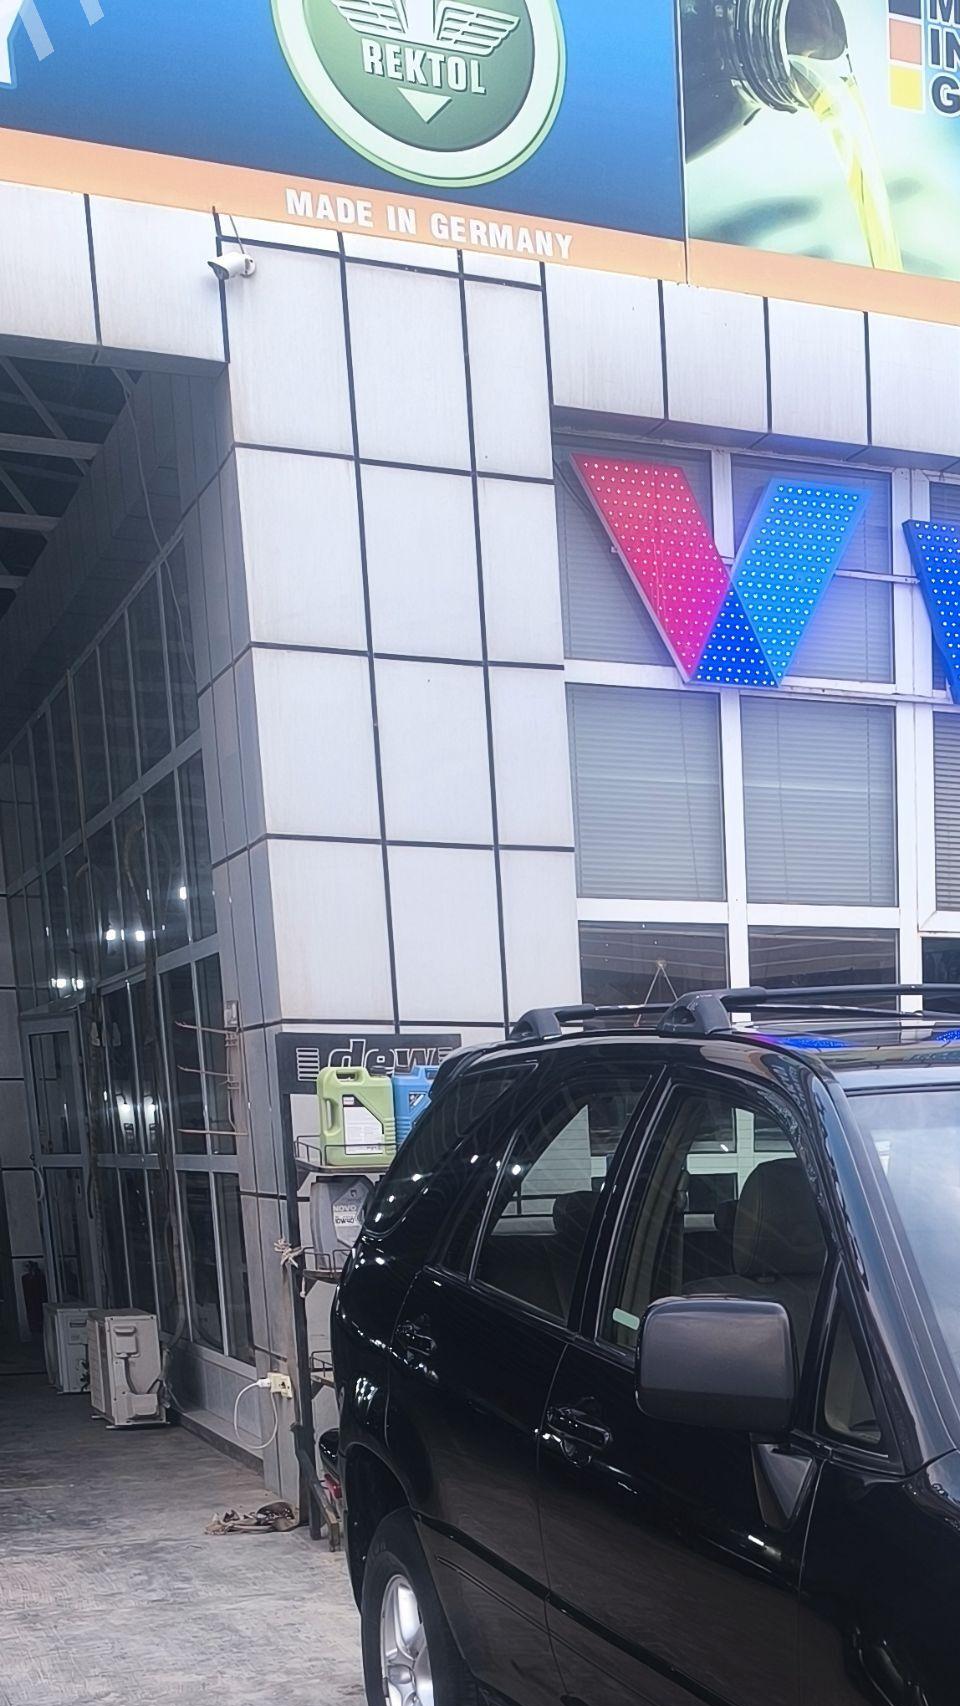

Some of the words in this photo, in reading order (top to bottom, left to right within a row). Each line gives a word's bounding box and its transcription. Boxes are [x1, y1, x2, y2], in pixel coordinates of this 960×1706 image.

[361, 38, 486, 95] REKTOL
[285, 188, 373, 227] MADE
[387, 205, 416, 235] IN
[431, 212, 573, 260] GERMANY
